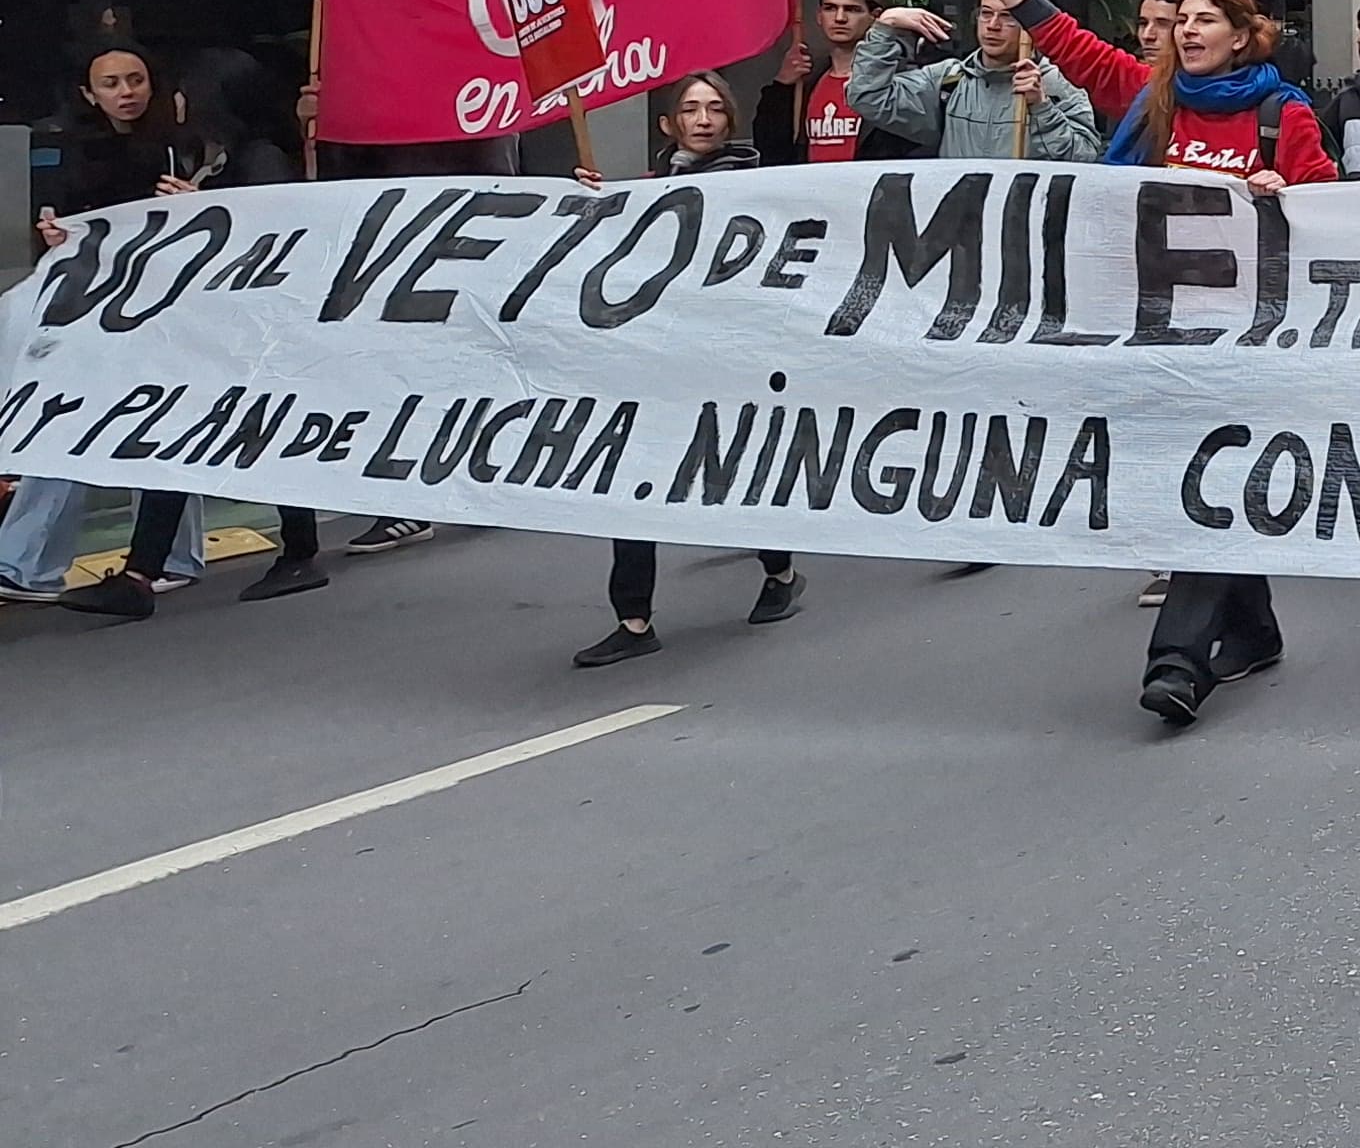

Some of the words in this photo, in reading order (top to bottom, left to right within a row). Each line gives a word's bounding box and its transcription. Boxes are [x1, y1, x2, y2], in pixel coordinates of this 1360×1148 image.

[455, 76, 521, 135] en
[1182, 139, 1259, 173] Basta!
[38, 205, 232, 332] NO
[204, 229, 308, 291] AL
[318, 186, 702, 329] VETO
[703, 215, 828, 289] DE
[68, 383, 298, 469] PLAN
[280, 410, 369, 461] DE
[362, 393, 653, 500] LUCHA.
[665, 370, 1112, 531] NINGUNA
